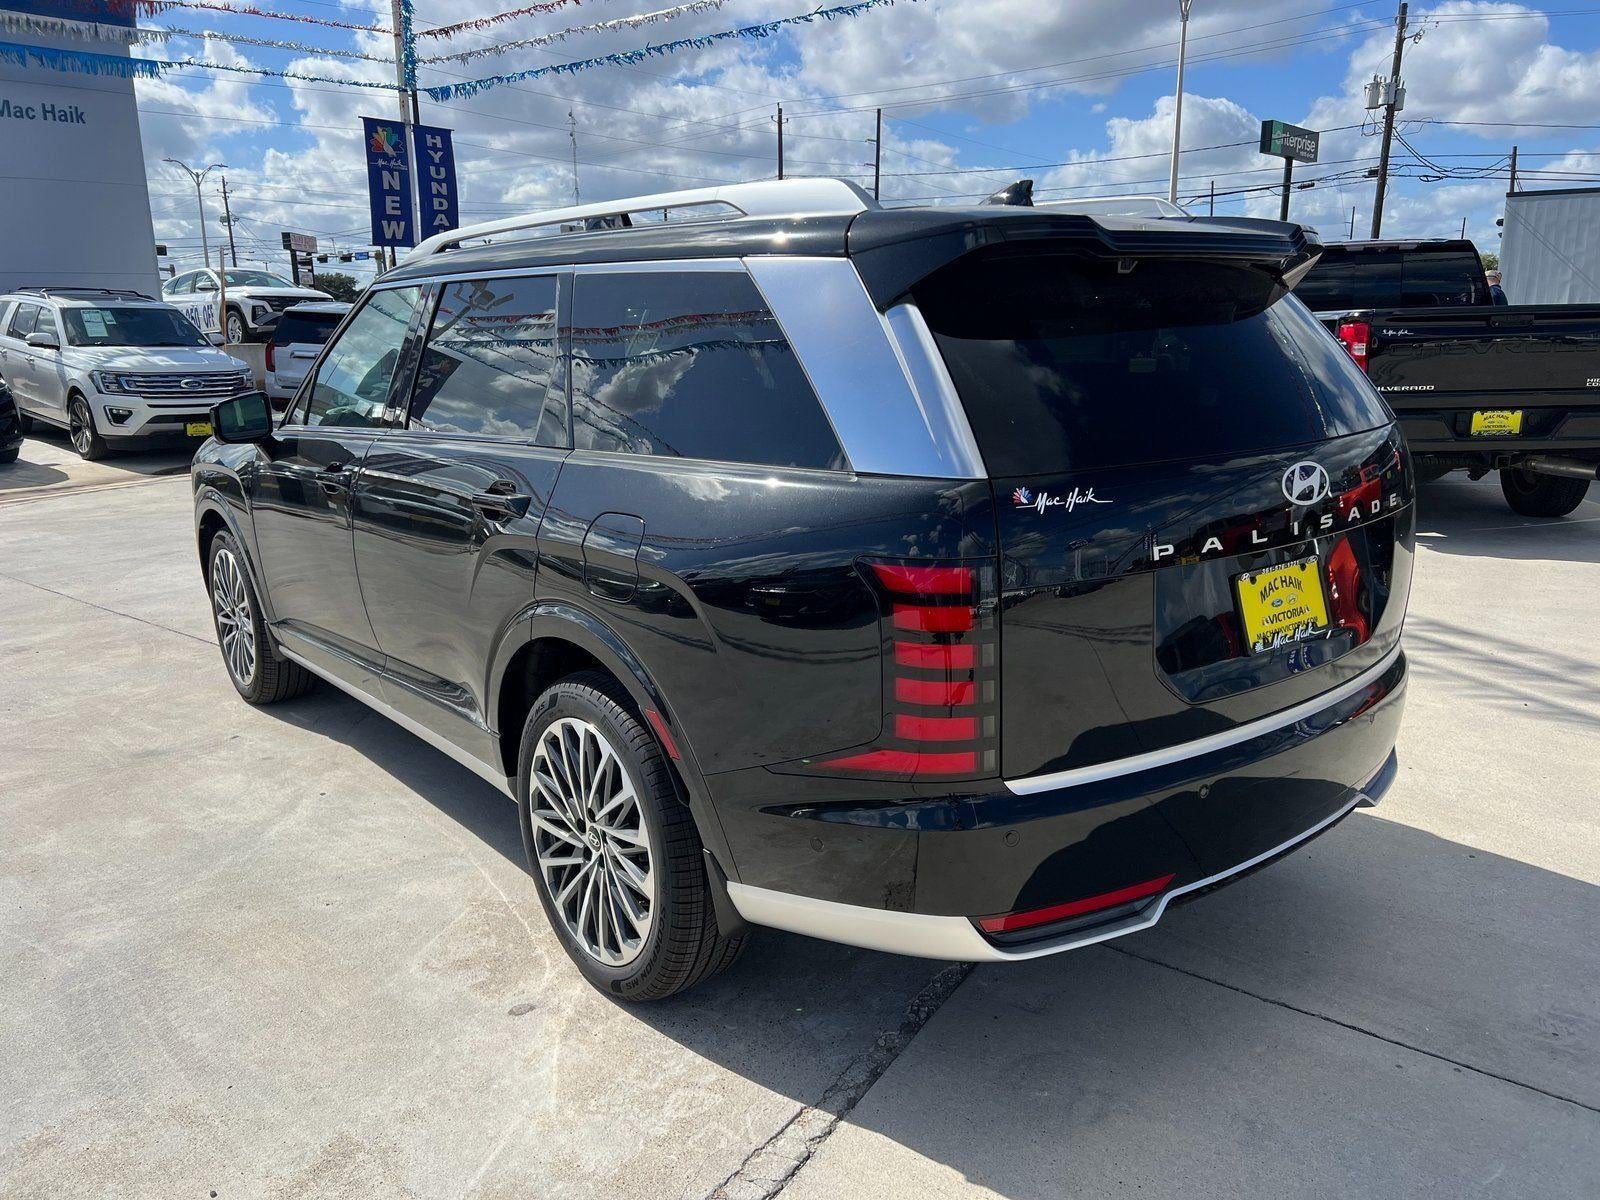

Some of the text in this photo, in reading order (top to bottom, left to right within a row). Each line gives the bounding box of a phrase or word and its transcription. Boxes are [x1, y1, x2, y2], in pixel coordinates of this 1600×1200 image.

[0, 99, 86, 124] Mac Haik
[1272, 130, 1316, 153] enterprise
[381, 170, 405, 240] NEW
[1027, 487, 1106, 514] Mac Haik
[1153, 493, 1398, 561] PALISADE
[1260, 577, 1280, 604] MAC
[1280, 575, 1304, 592] HAIK
[1267, 605, 1305, 624] VICTORIA
[1268, 620, 1321, 649] Mac Haik
